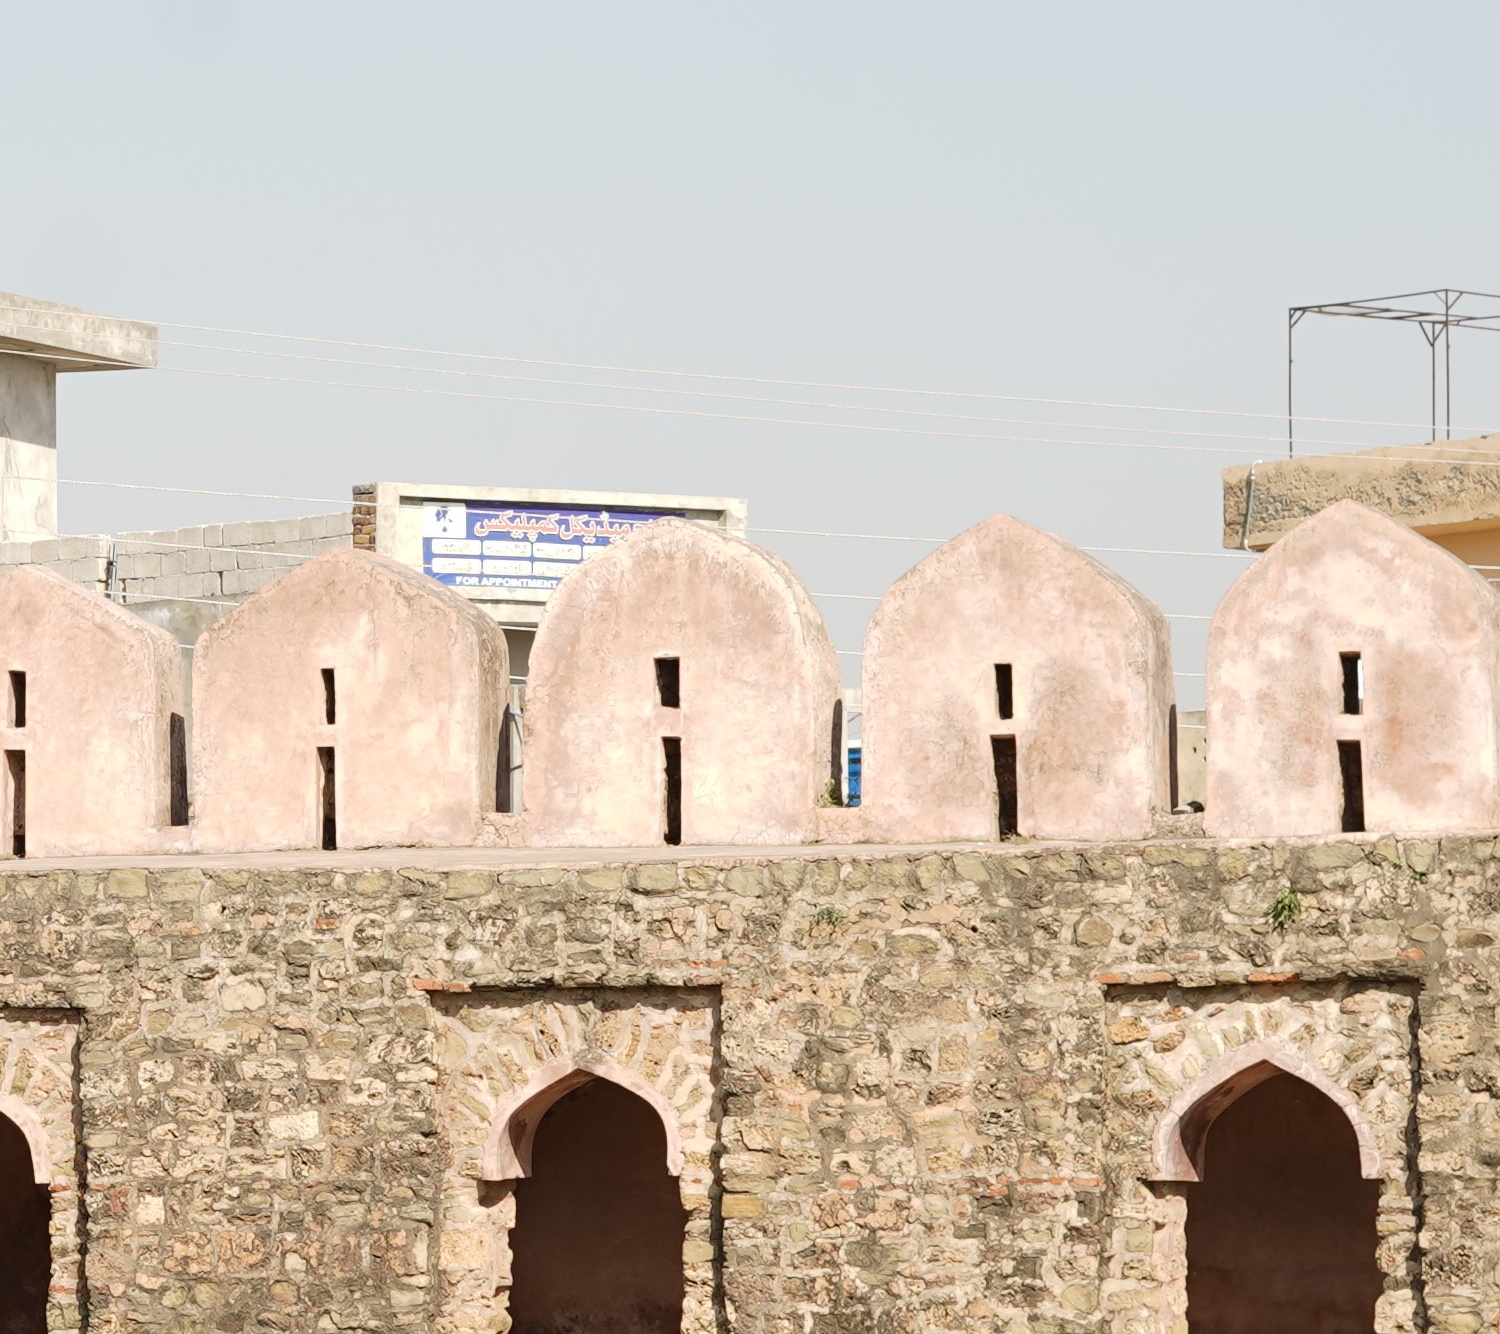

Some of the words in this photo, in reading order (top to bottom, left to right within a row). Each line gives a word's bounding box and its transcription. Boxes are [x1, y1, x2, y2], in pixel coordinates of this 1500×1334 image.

[473, 510, 560, 542] کمپلیکس
[456, 575, 480, 586] FOR
[480, 576, 558, 589] APPOINTMENT
